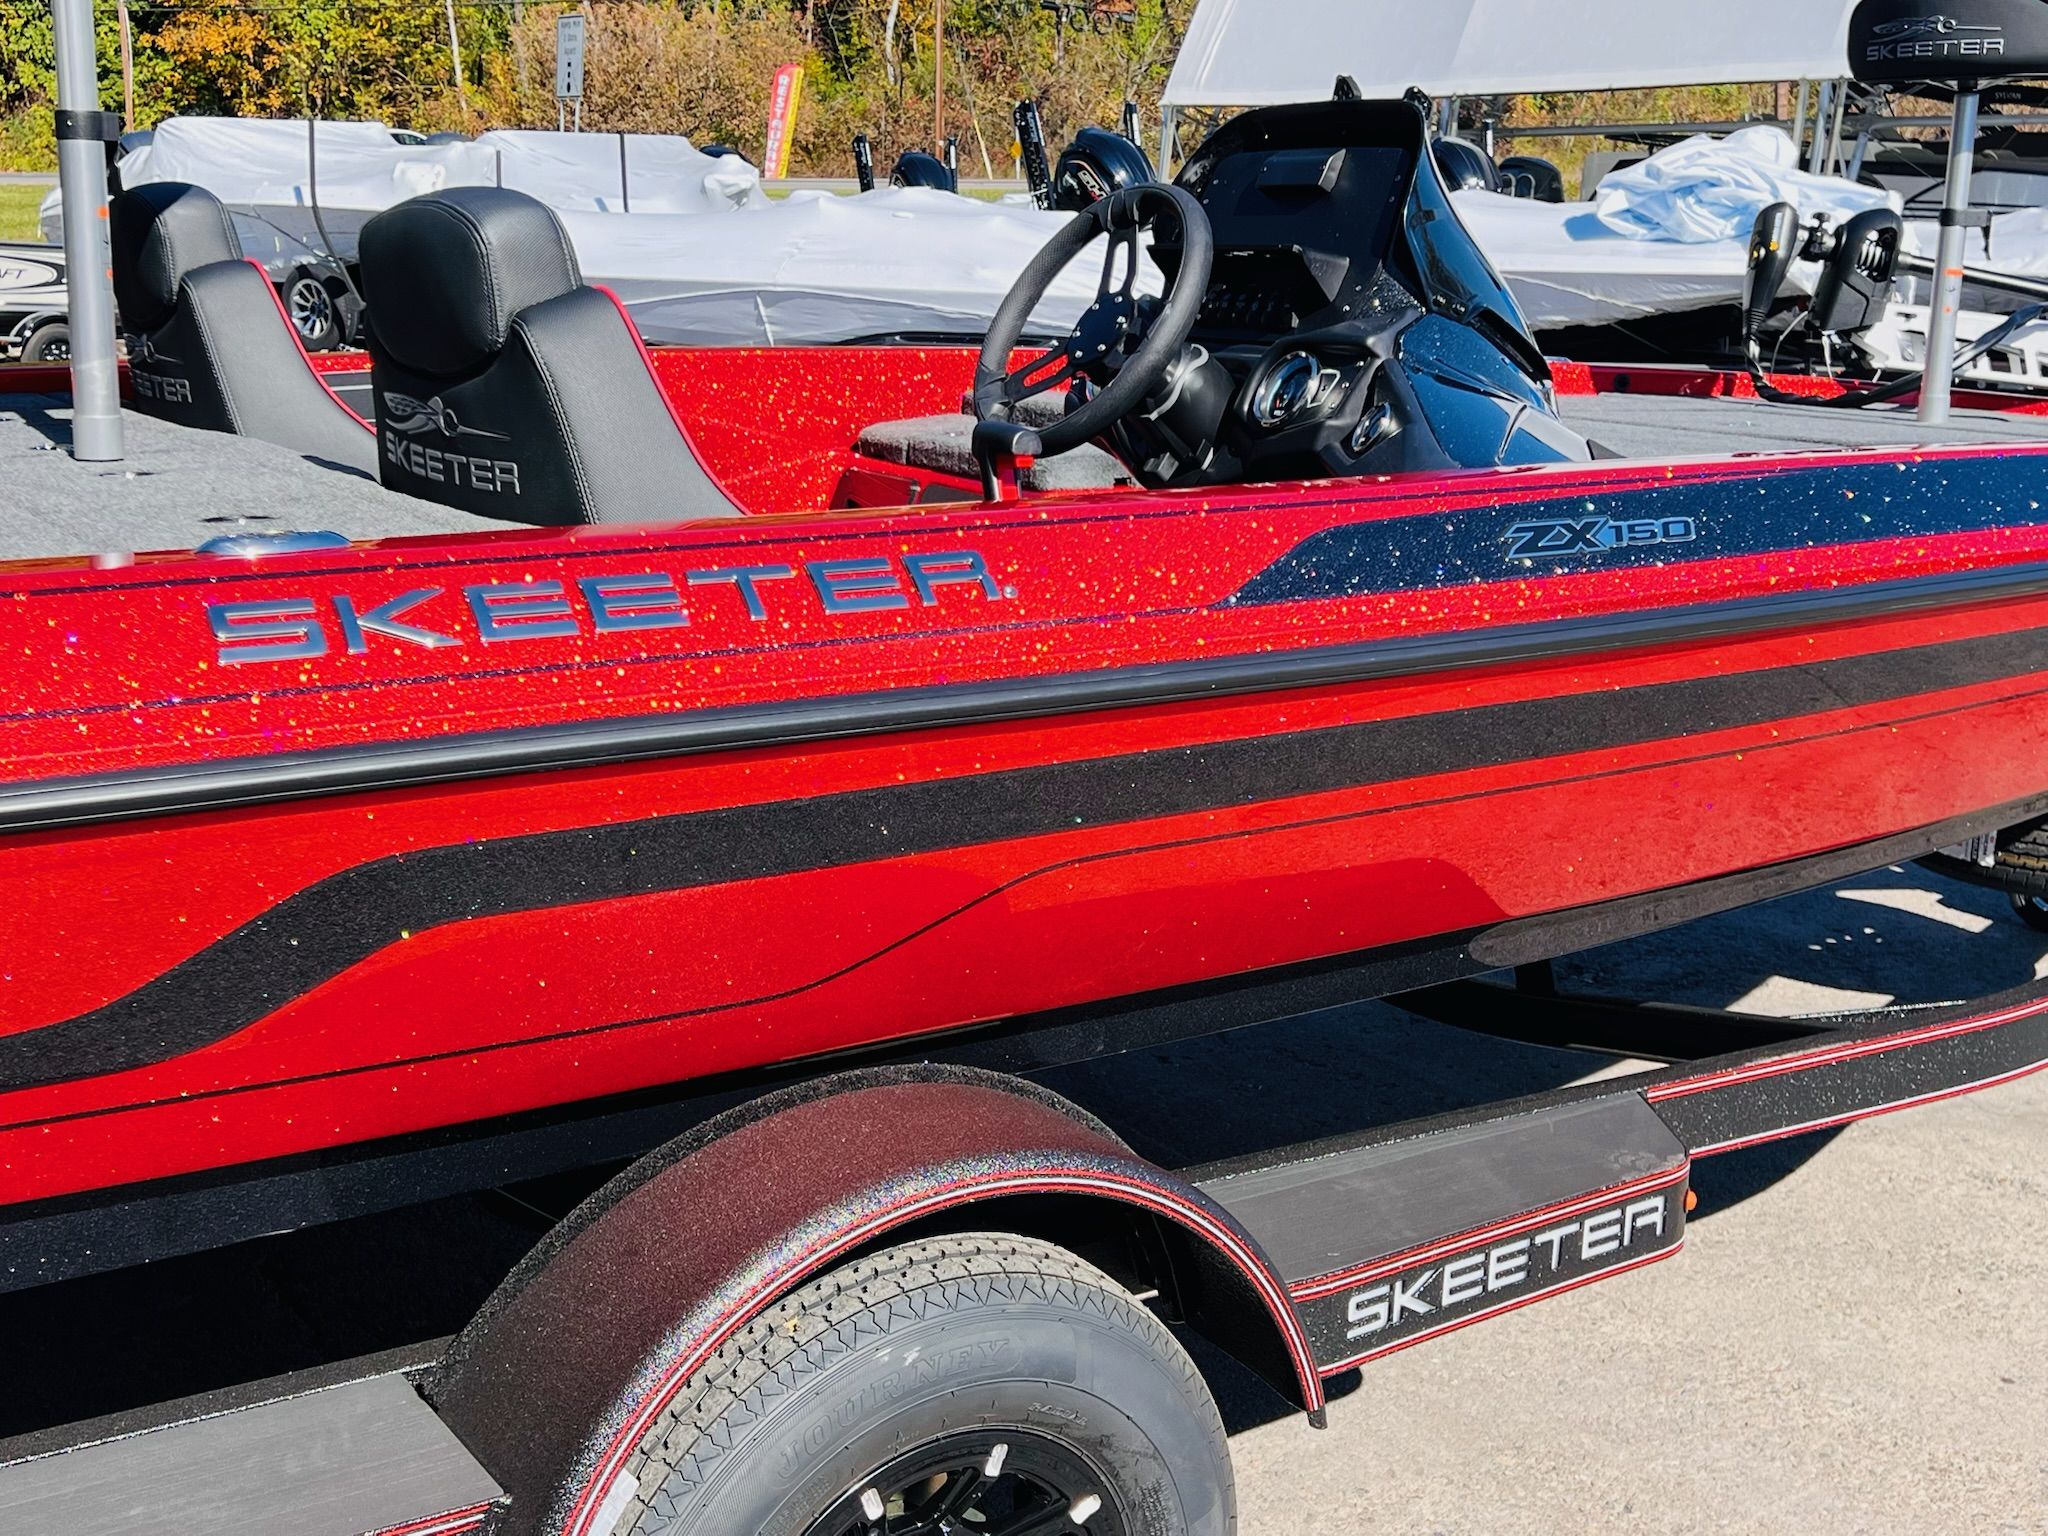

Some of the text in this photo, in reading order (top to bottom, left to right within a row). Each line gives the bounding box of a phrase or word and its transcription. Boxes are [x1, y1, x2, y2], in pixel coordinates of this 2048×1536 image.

[1866, 38, 2004, 61] SKEETER
[129, 367, 193, 403] EETER
[385, 431, 521, 495] SKEETER
[1504, 516, 1697, 559] ZX150
[208, 549, 1001, 665] SKEETER
[1346, 1195, 1667, 1340] SKEETER
[778, 1338, 1009, 1479] JOURNEY
